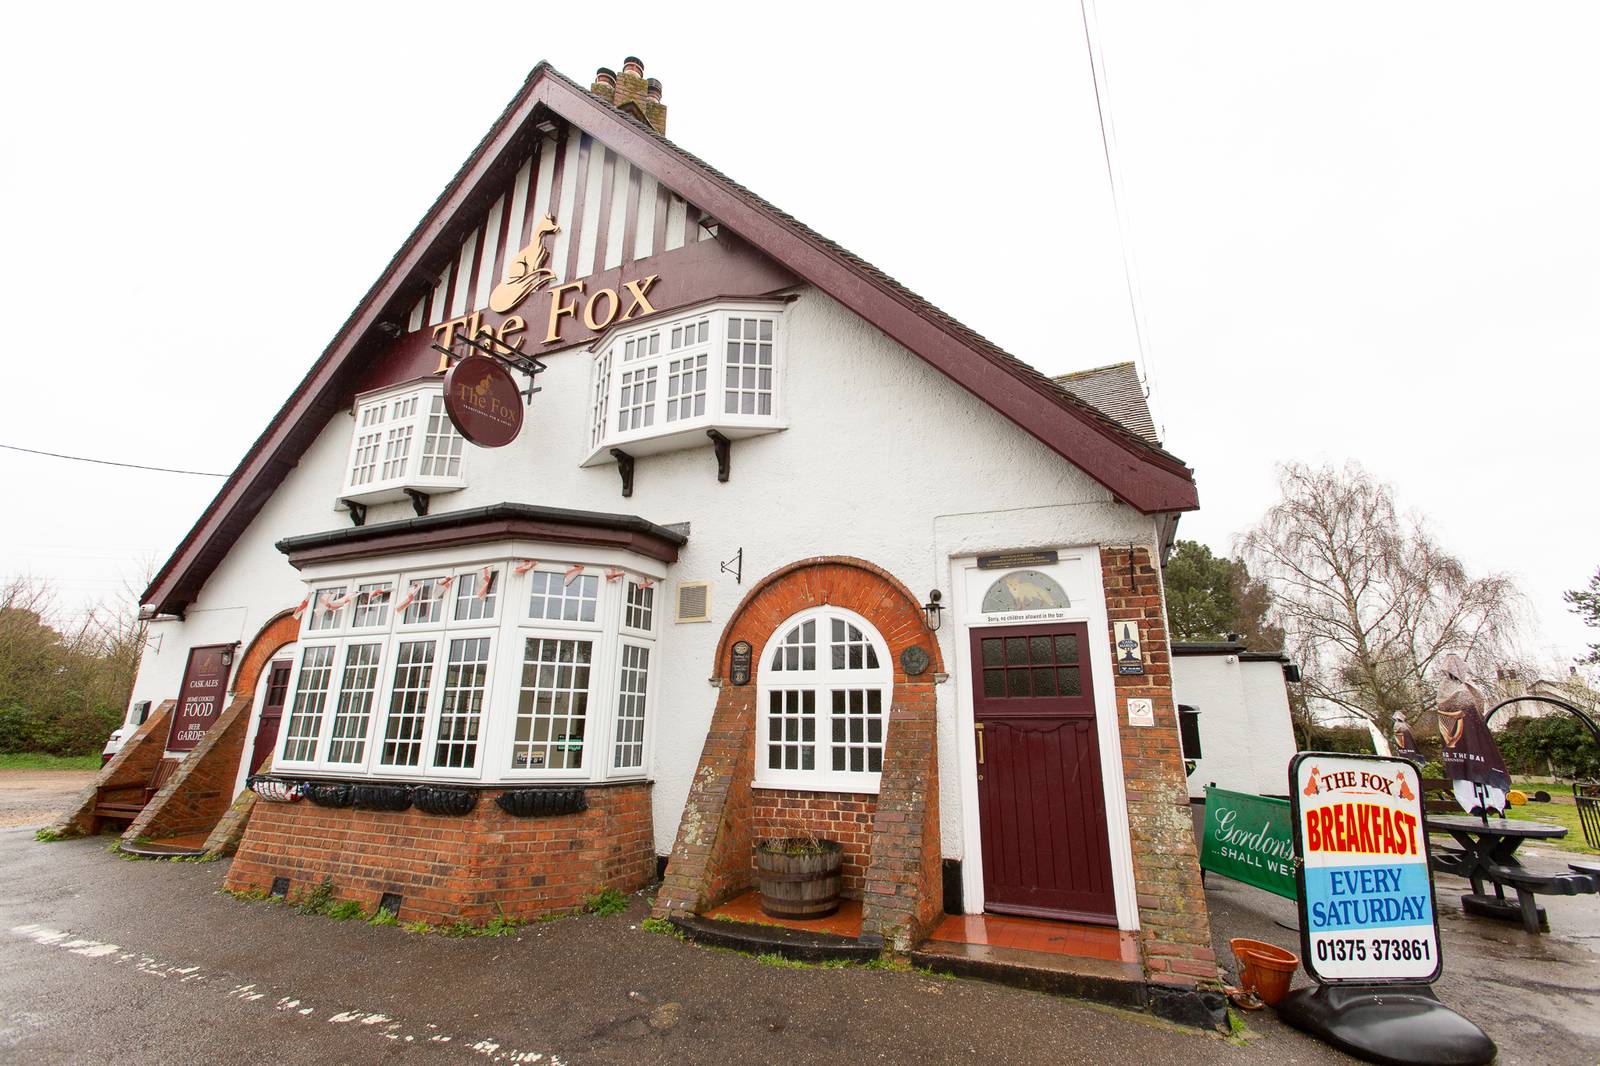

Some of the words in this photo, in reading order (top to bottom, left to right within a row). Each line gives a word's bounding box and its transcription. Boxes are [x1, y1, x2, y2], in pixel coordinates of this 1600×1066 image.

[432, 311, 526, 376] The
[540, 274, 661, 345] Fox
[459, 382, 486, 408] The
[489, 397, 515, 422] Fox
[190, 680, 205, 688] CASK
[205, 679, 219, 687] ALES
[183, 702, 213, 717] FOOD
[1321, 771, 1357, 792] THE
[1361, 772, 1394, 796] FOX
[1215, 807, 1295, 861] Gordon's
[1306, 803, 1418, 856] BREAKFAST
[1267, 859, 1296, 878] WE?
[1330, 868, 1402, 896] EVERY
[1312, 895, 1426, 927] SATURDAY
[1317, 939, 1367, 962] 01375
[1372, 939, 1431, 961] 373861
